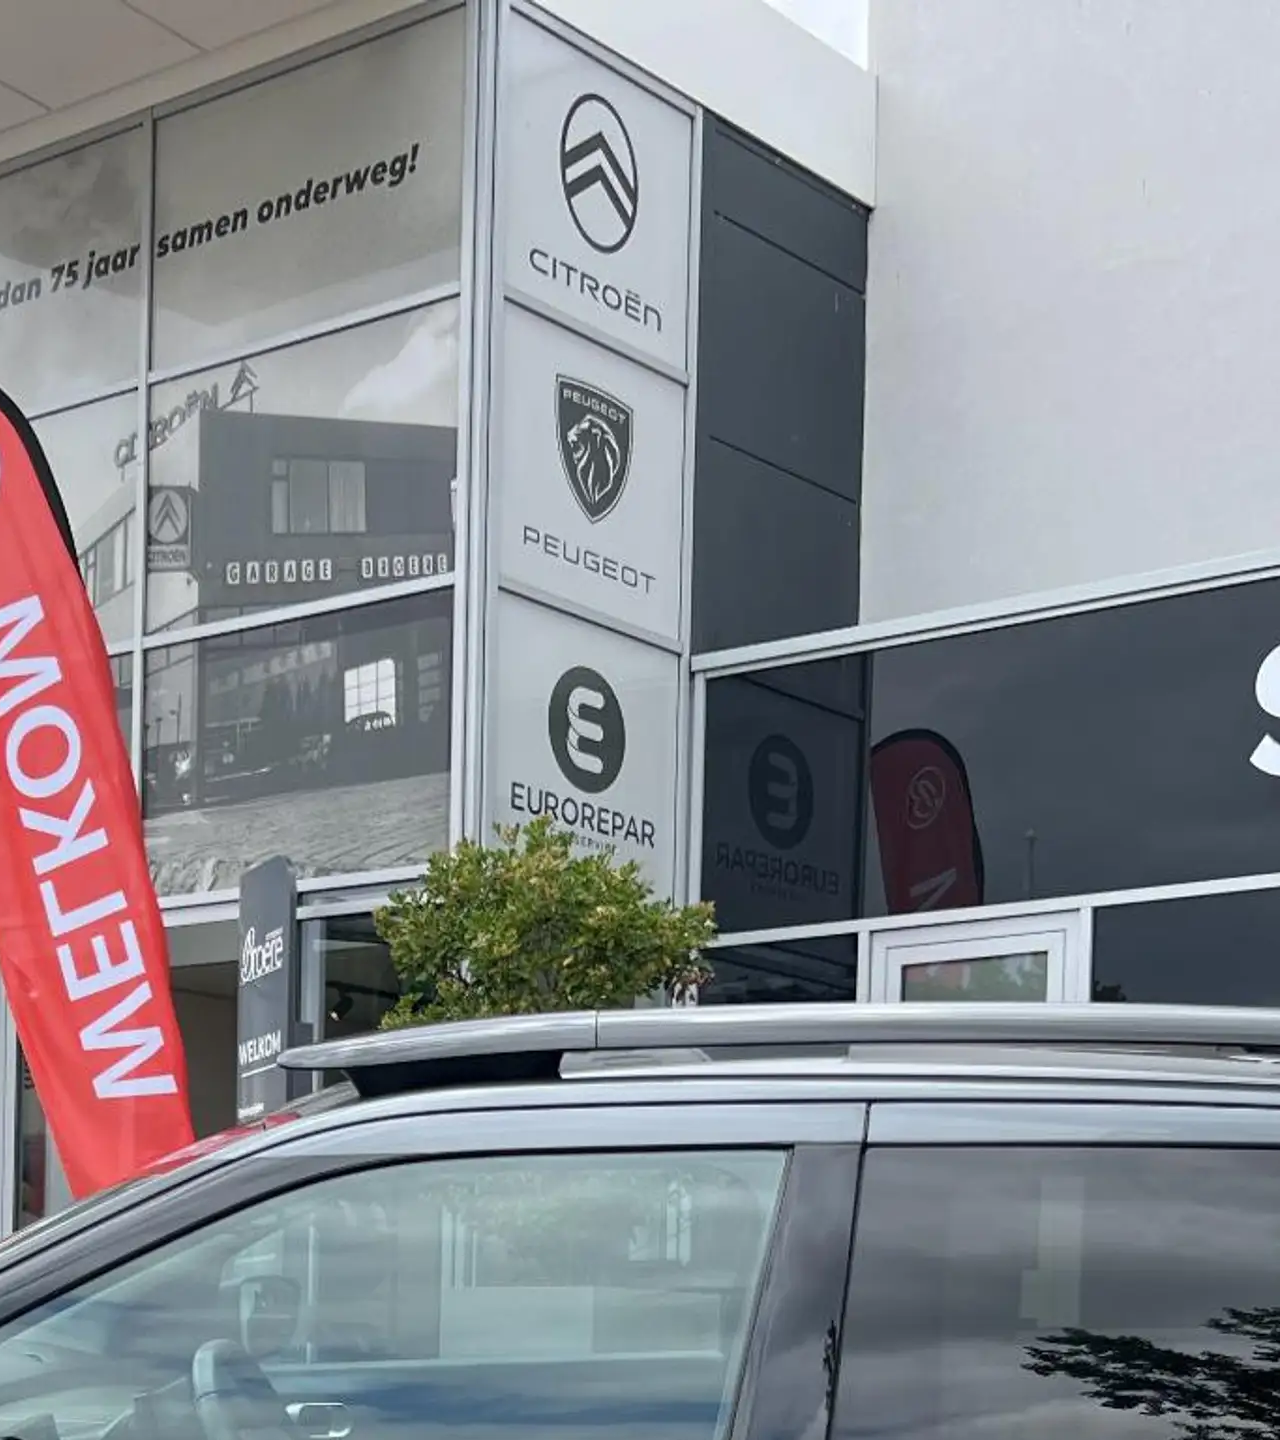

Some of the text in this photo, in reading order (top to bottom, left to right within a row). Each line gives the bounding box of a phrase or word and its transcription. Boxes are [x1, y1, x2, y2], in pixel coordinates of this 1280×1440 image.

[50, 259, 79, 292] 75
[82, 243, 140, 289] jaar
[156, 207, 248, 258] samen
[257, 144, 419, 223] onderweg!
[529, 247, 662, 332] CITROËN
[114, 383, 219, 466] CIROËN
[563, 387, 627, 424] PEUGEOT
[228, 559, 332, 584] GARAGE
[523, 525, 656, 593] PEUGEOT
[511, 781, 656, 849] EUROREPAR
[238, 1030, 281, 1066] WELKOM
